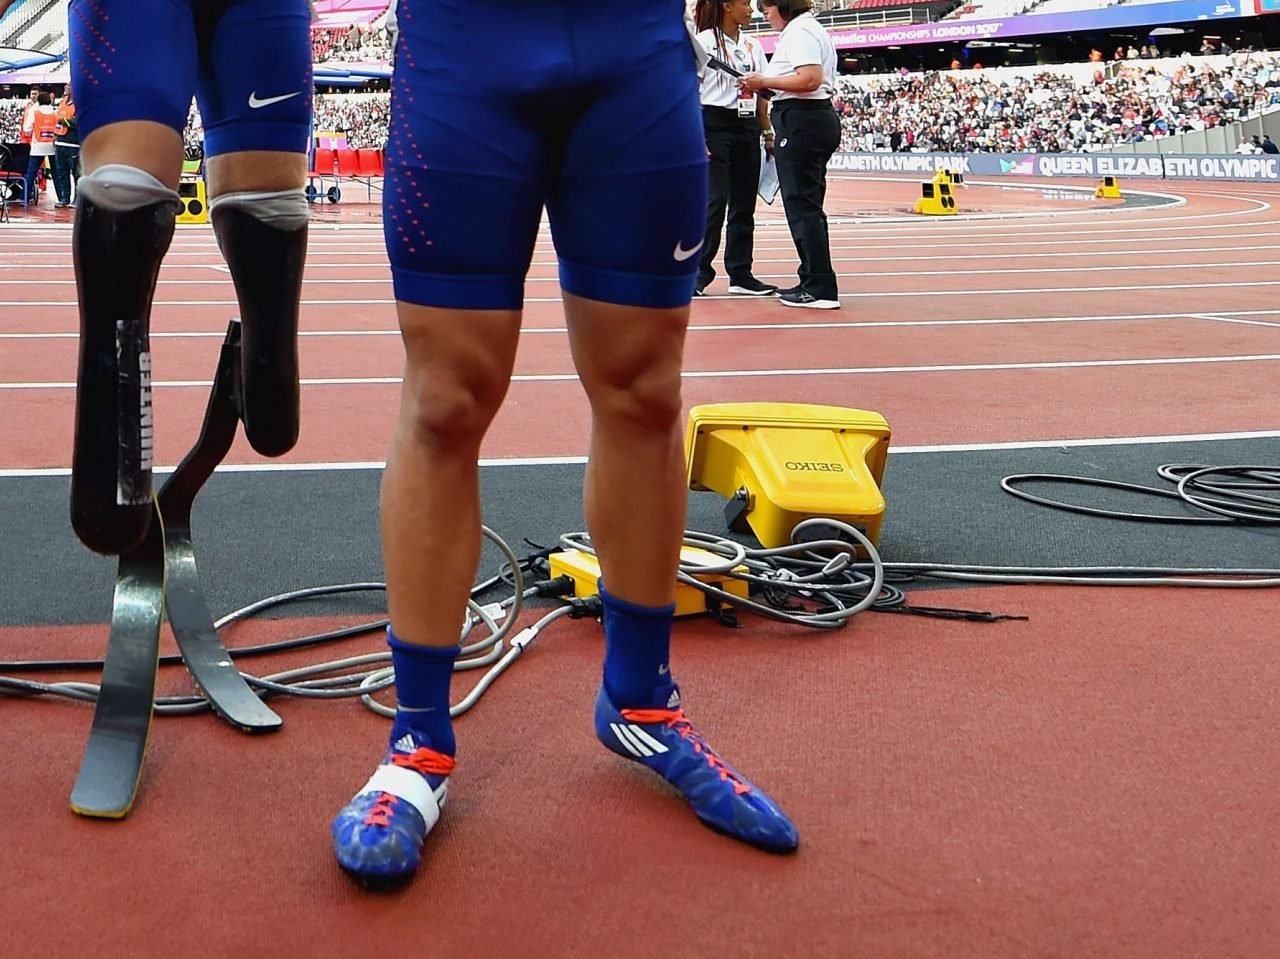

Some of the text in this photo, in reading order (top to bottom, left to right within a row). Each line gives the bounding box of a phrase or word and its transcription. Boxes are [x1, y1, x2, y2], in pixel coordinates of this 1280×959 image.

[868, 29, 931, 43] CHAMPIONSHIPS
[933, 24, 976, 38] LONDON
[976, 23, 1000, 36] 2017
[826, 155, 970, 172] IZABETH OLYMPIC PARK
[1039, 157, 1278, 179] QUEEN ELIZABETH OLYMPIC
[785, 461, 844, 473] SEIKO
